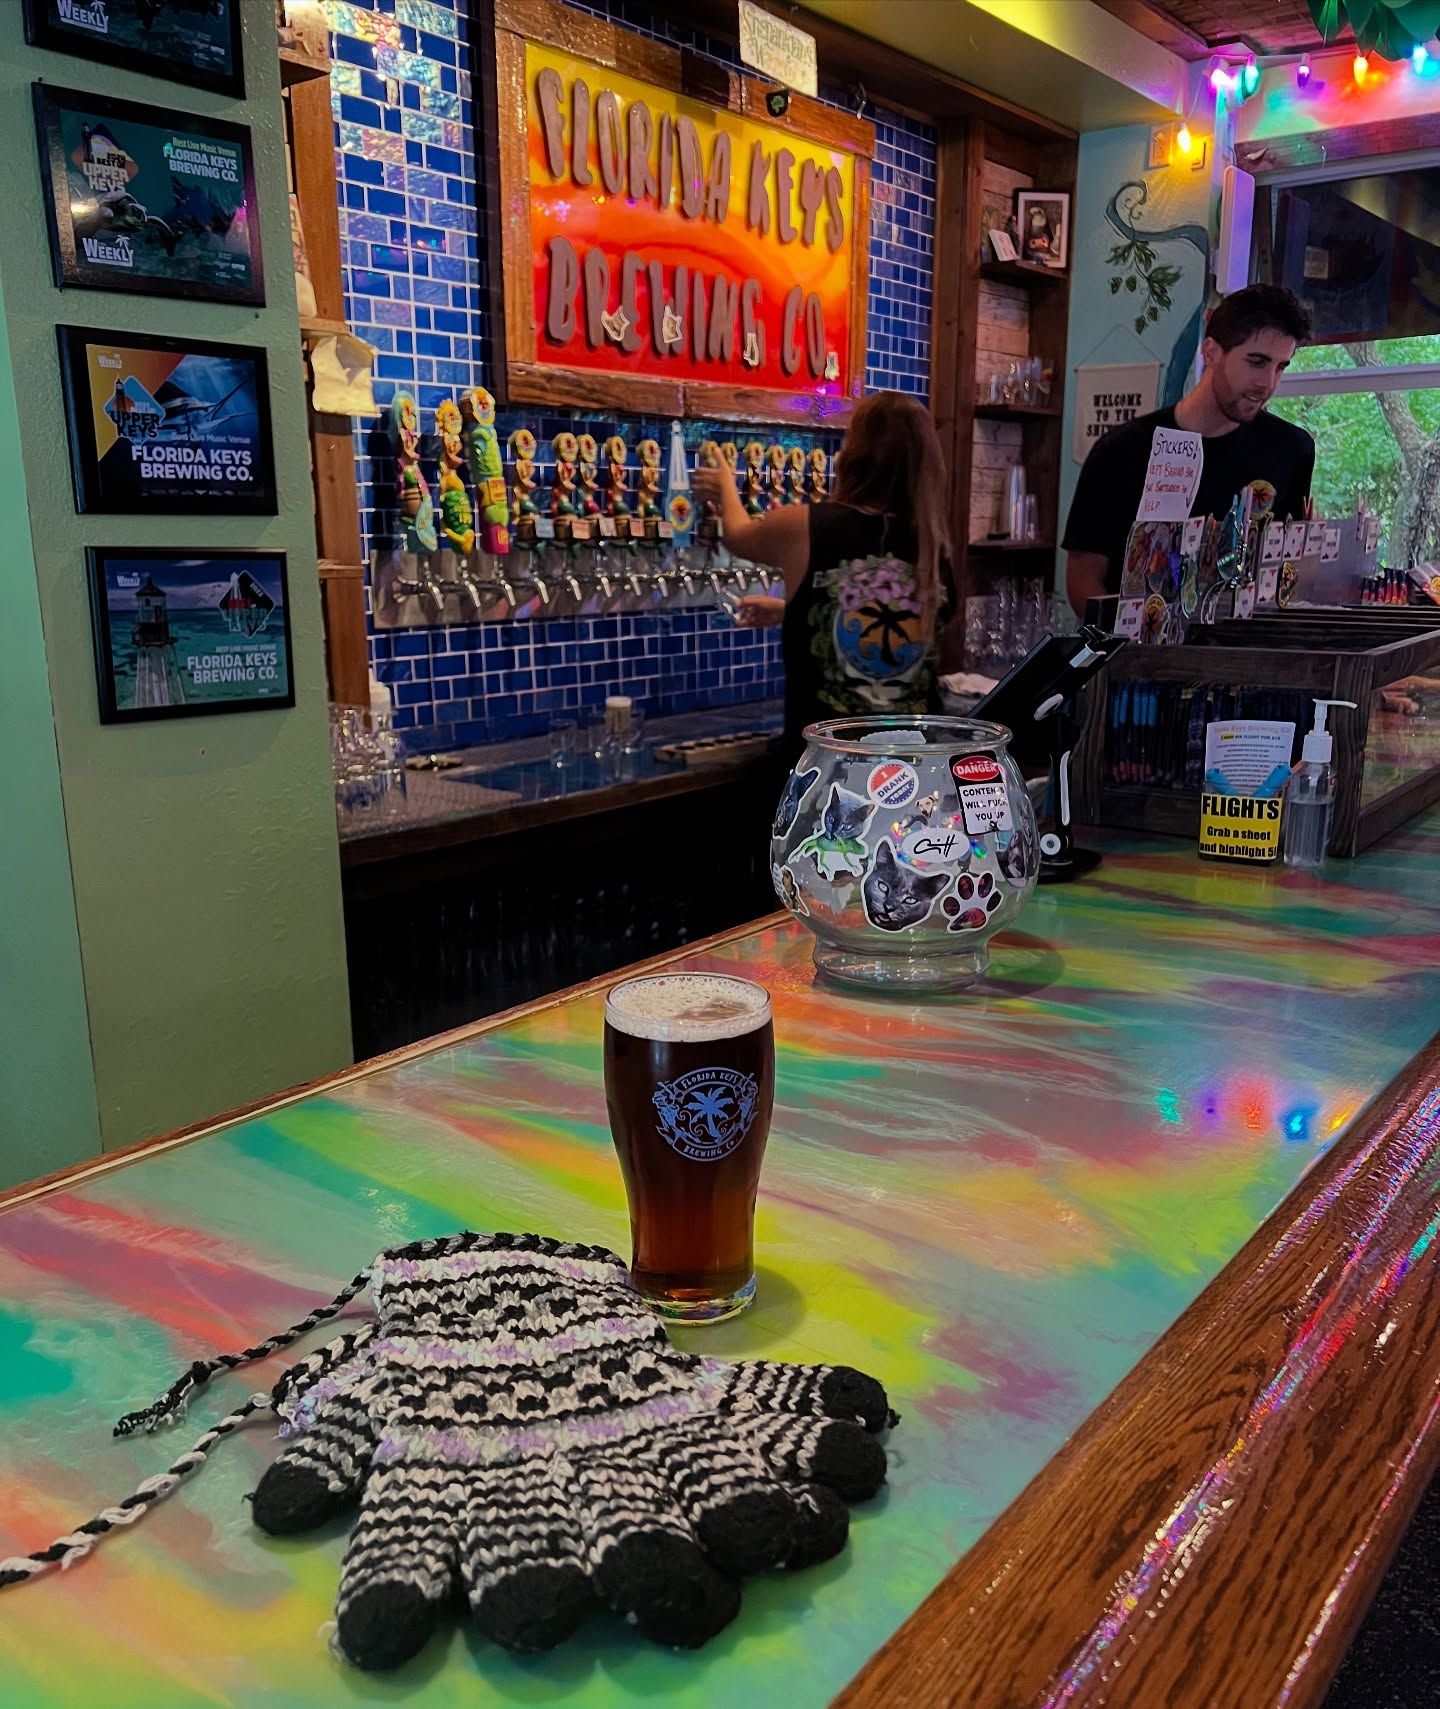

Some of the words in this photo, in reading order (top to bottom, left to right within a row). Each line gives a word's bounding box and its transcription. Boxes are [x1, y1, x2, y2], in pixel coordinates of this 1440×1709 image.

[57, 0, 109, 32] WEEKLY
[163, 146, 209, 166] FLORIDA
[210, 155, 238, 171] KEYS
[538, 67, 731, 224] FLORIDA
[750, 140, 844, 250] KEYS
[83, 161, 129, 182] UPPER
[169, 159, 220, 179] BREWING
[221, 169, 239, 182] CO.
[89, 176, 126, 193] KEYS
[82, 236, 134, 267] WEEKLY
[548, 236, 766, 366] BREWING
[1093, 393, 1141, 407] WELCOME
[110, 411, 160, 426] UPPER
[1096, 409, 1109, 422] TO
[117, 420, 158, 438] KEYS
[131, 445, 207, 464] FLORIDA
[210, 449, 252, 466] KEYS
[140, 462, 223, 480] BREWING
[225, 466, 254, 481] CO.
[187, 654, 242, 671] FLORIDA
[245, 652, 277, 667] KEYS
[193, 667, 255, 684] BREWING
[258, 666, 278, 680] CO.
[956, 763, 997, 775] DANGER
[877, 771, 909, 798] DRANK
[890, 784, 910, 801] TODAY
[975, 812, 993, 821] YOU
[1202, 795, 1279, 820] FLIGHTS
[1207, 826, 1230, 838] Grab
[1233, 830, 1239, 838] a
[1241, 830, 1271, 841] sheet
[1200, 842, 1216, 853] and
[1219, 844, 1266, 857] highlight
[680, 1071, 716, 1089] FLORIDA
[719, 1072, 738, 1084] KEYS
[683, 1144, 723, 1158] BREWING
